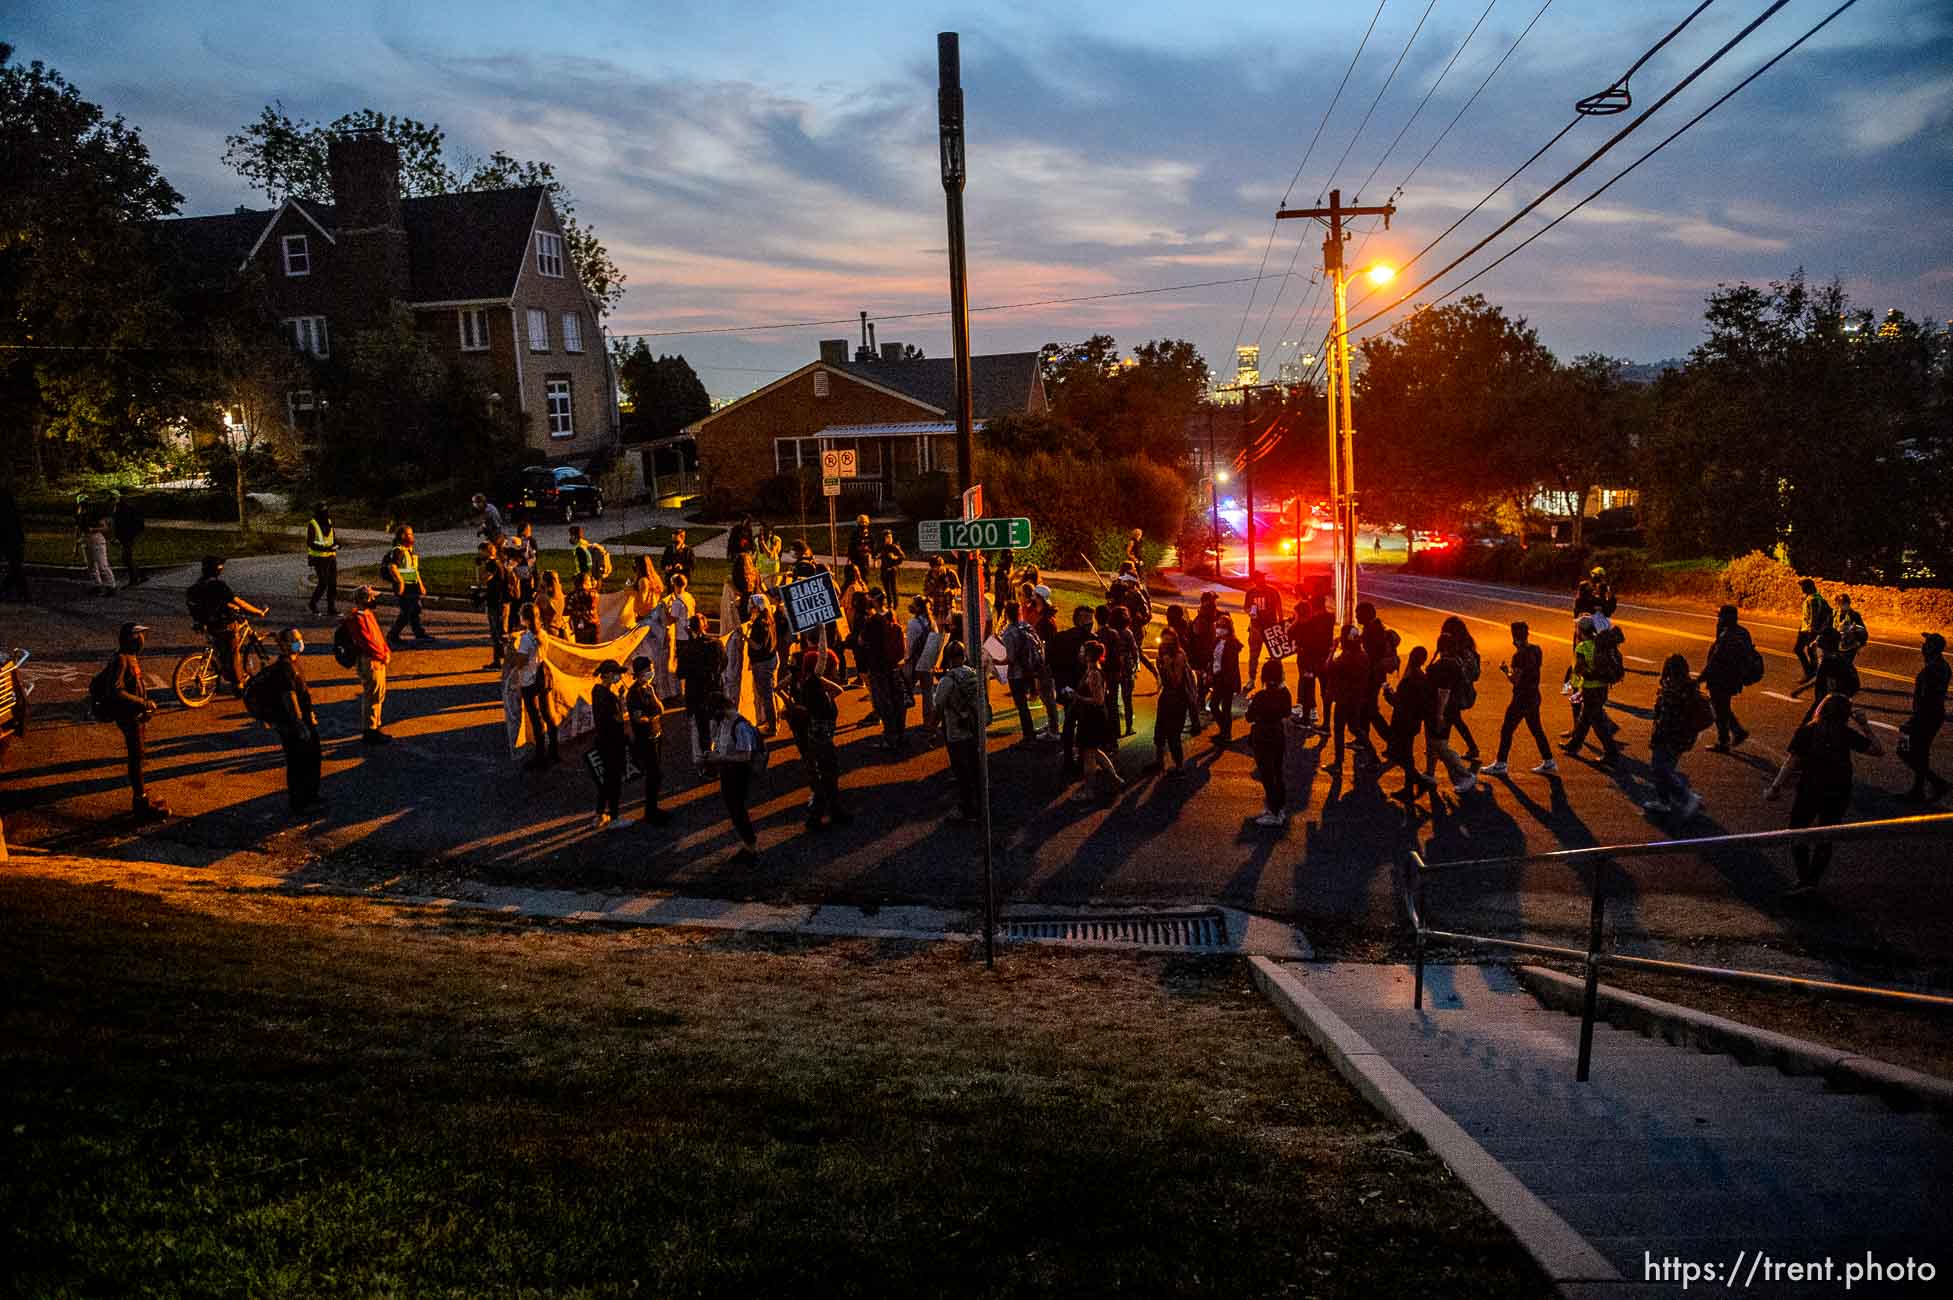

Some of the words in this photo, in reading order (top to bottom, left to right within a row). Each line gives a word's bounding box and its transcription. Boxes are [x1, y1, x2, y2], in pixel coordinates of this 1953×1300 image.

[949, 523, 998, 546] 1200
[1008, 521, 1020, 545] E
[790, 577, 826, 600] BLACK
[797, 592, 827, 613] LIVES
[796, 605, 836, 629] MATTER
